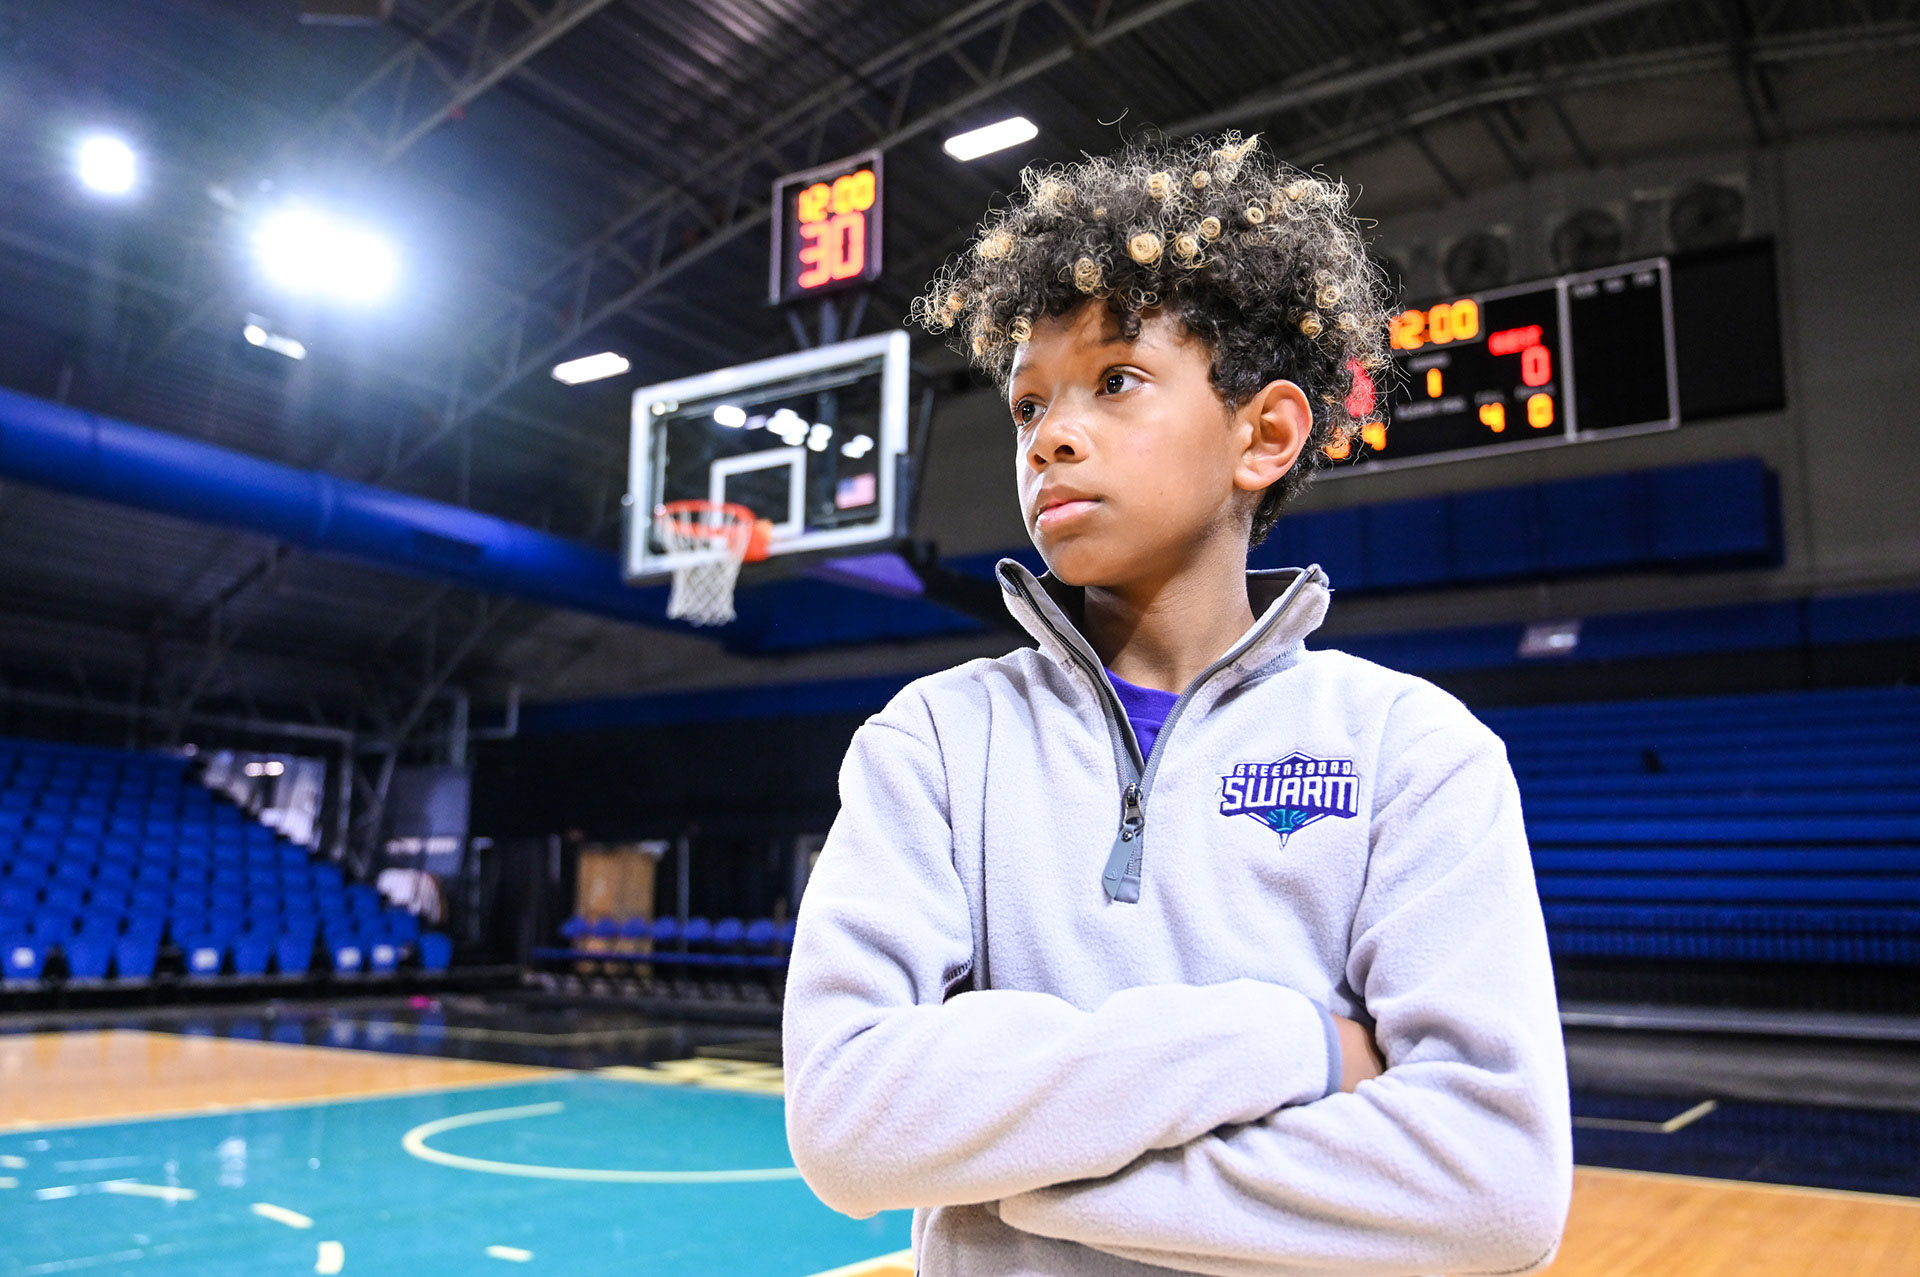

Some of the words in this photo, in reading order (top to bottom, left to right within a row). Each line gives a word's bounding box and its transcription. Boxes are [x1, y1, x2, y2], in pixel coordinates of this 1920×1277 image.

[798, 170, 875, 223] 12:00
[798, 211, 865, 288] 30
[1426, 368, 1442, 398] 1
[1521, 345, 1551, 387] 0
[1235, 761, 1352, 776] GREENSBORO
[1221, 775, 1358, 814] SWARM
